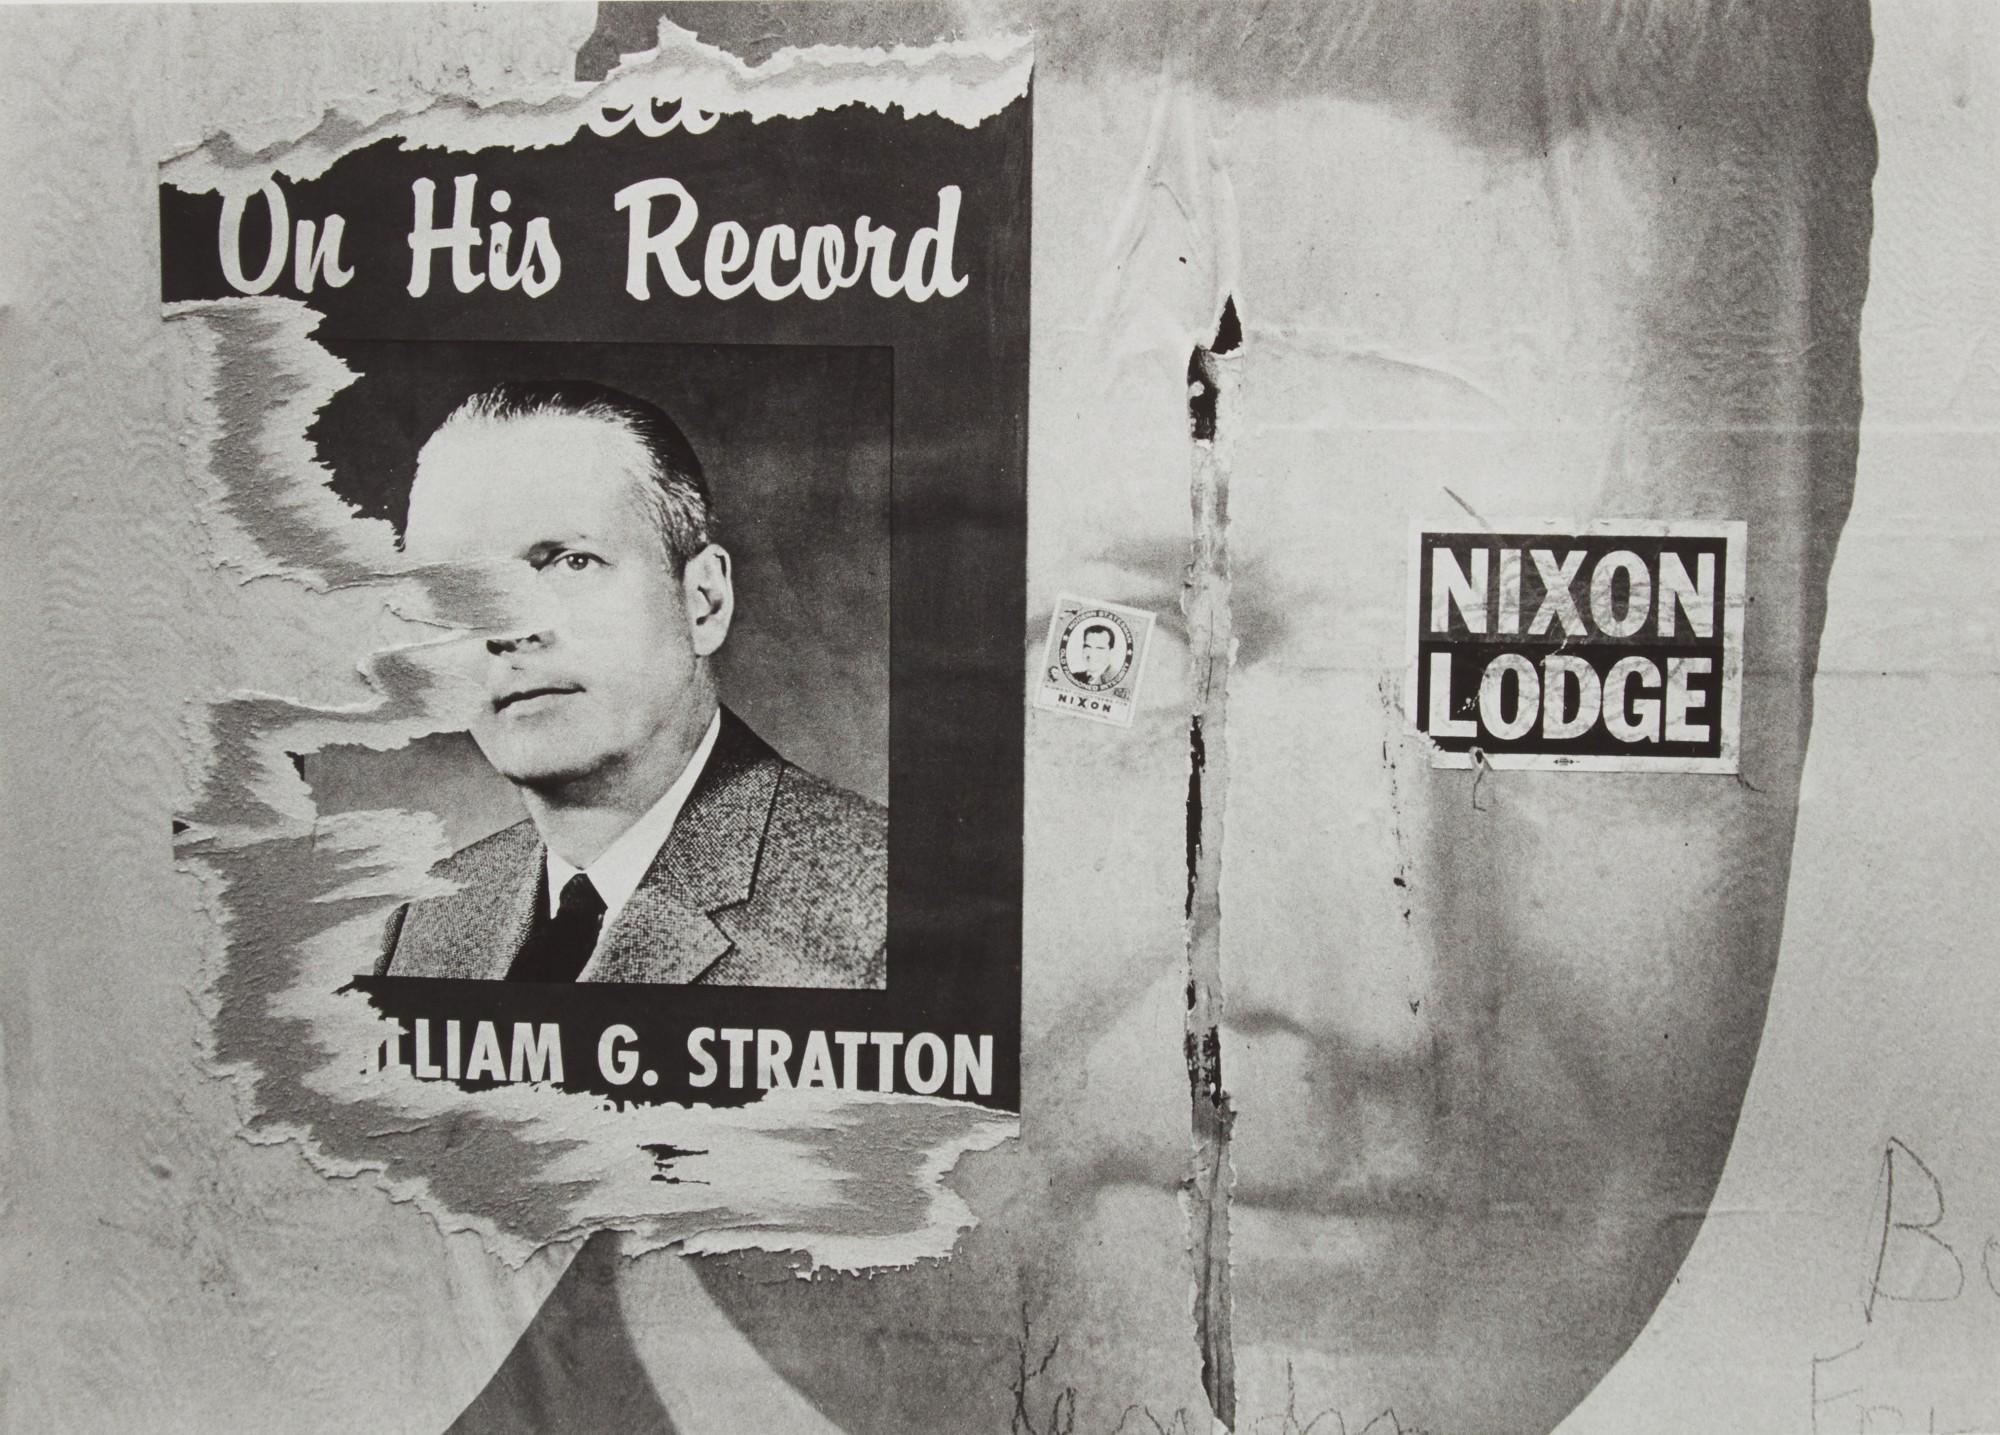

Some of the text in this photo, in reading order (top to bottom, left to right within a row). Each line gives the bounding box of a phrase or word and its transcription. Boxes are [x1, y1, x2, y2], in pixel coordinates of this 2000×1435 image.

[218, 173, 969, 303] On His Record
[1430, 546, 1716, 639] NIXON
[1057, 693, 1112, 713] NIXON
[1428, 652, 1713, 744] LODGE
[597, 1023, 659, 1087] G.
[686, 1026, 994, 1096] STRATTON
